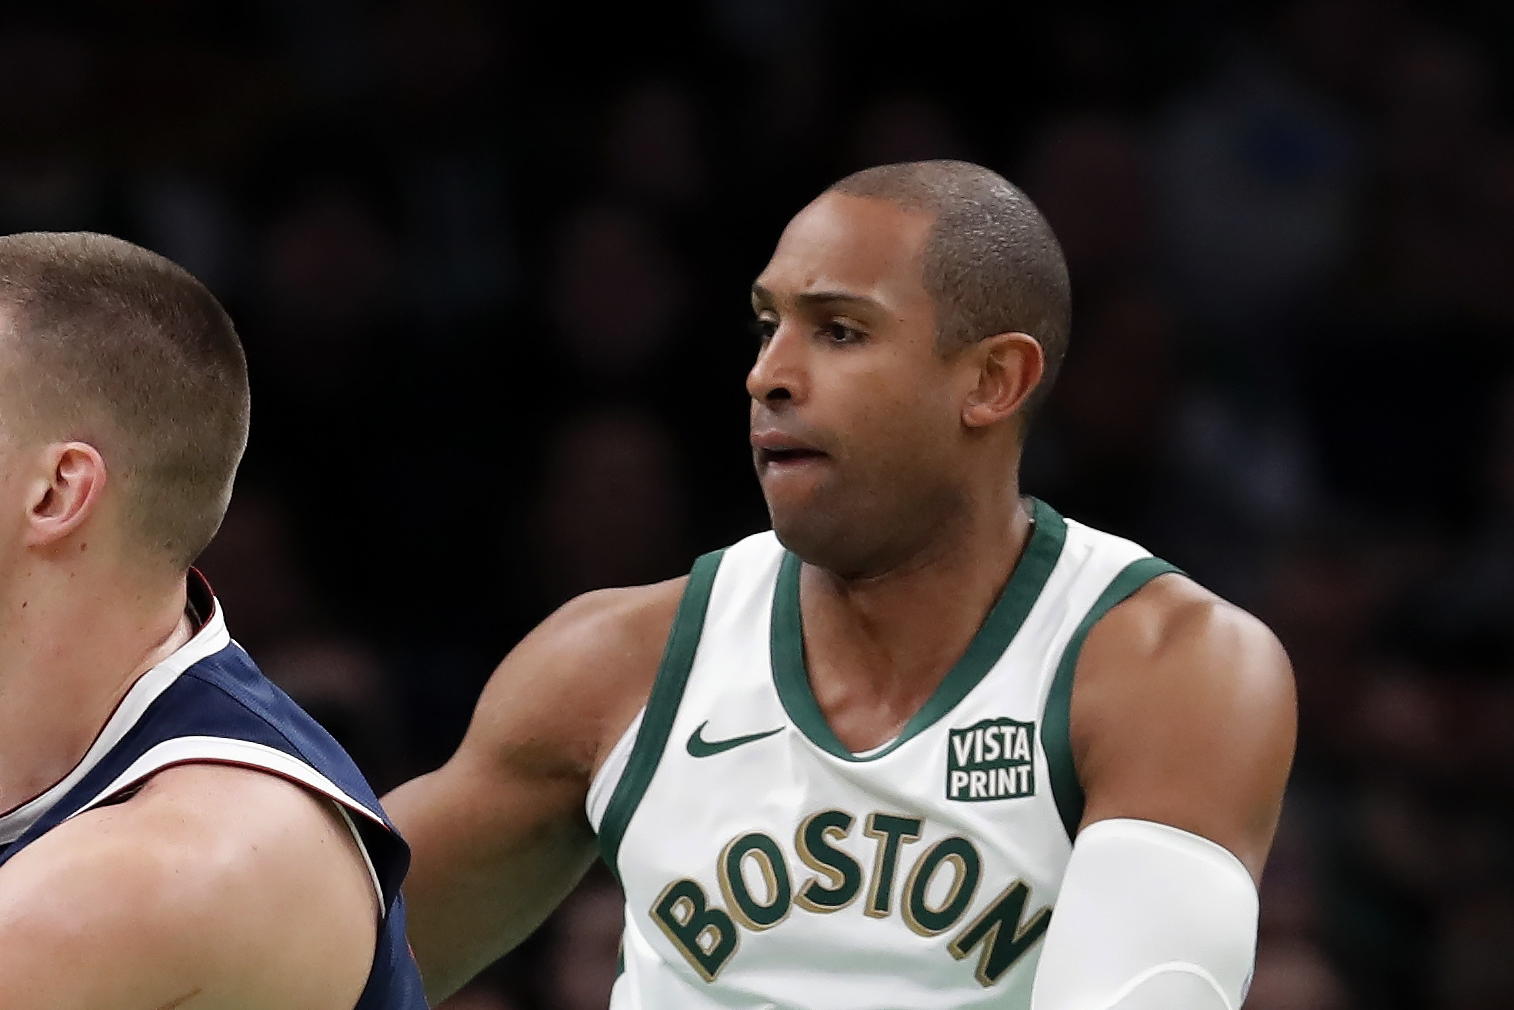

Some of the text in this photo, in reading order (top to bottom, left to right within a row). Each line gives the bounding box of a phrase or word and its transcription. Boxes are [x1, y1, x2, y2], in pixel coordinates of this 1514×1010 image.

[952, 726, 1031, 767] VISTA
[950, 764, 1031, 798] PRINT
[649, 810, 1053, 988] BOSTON
